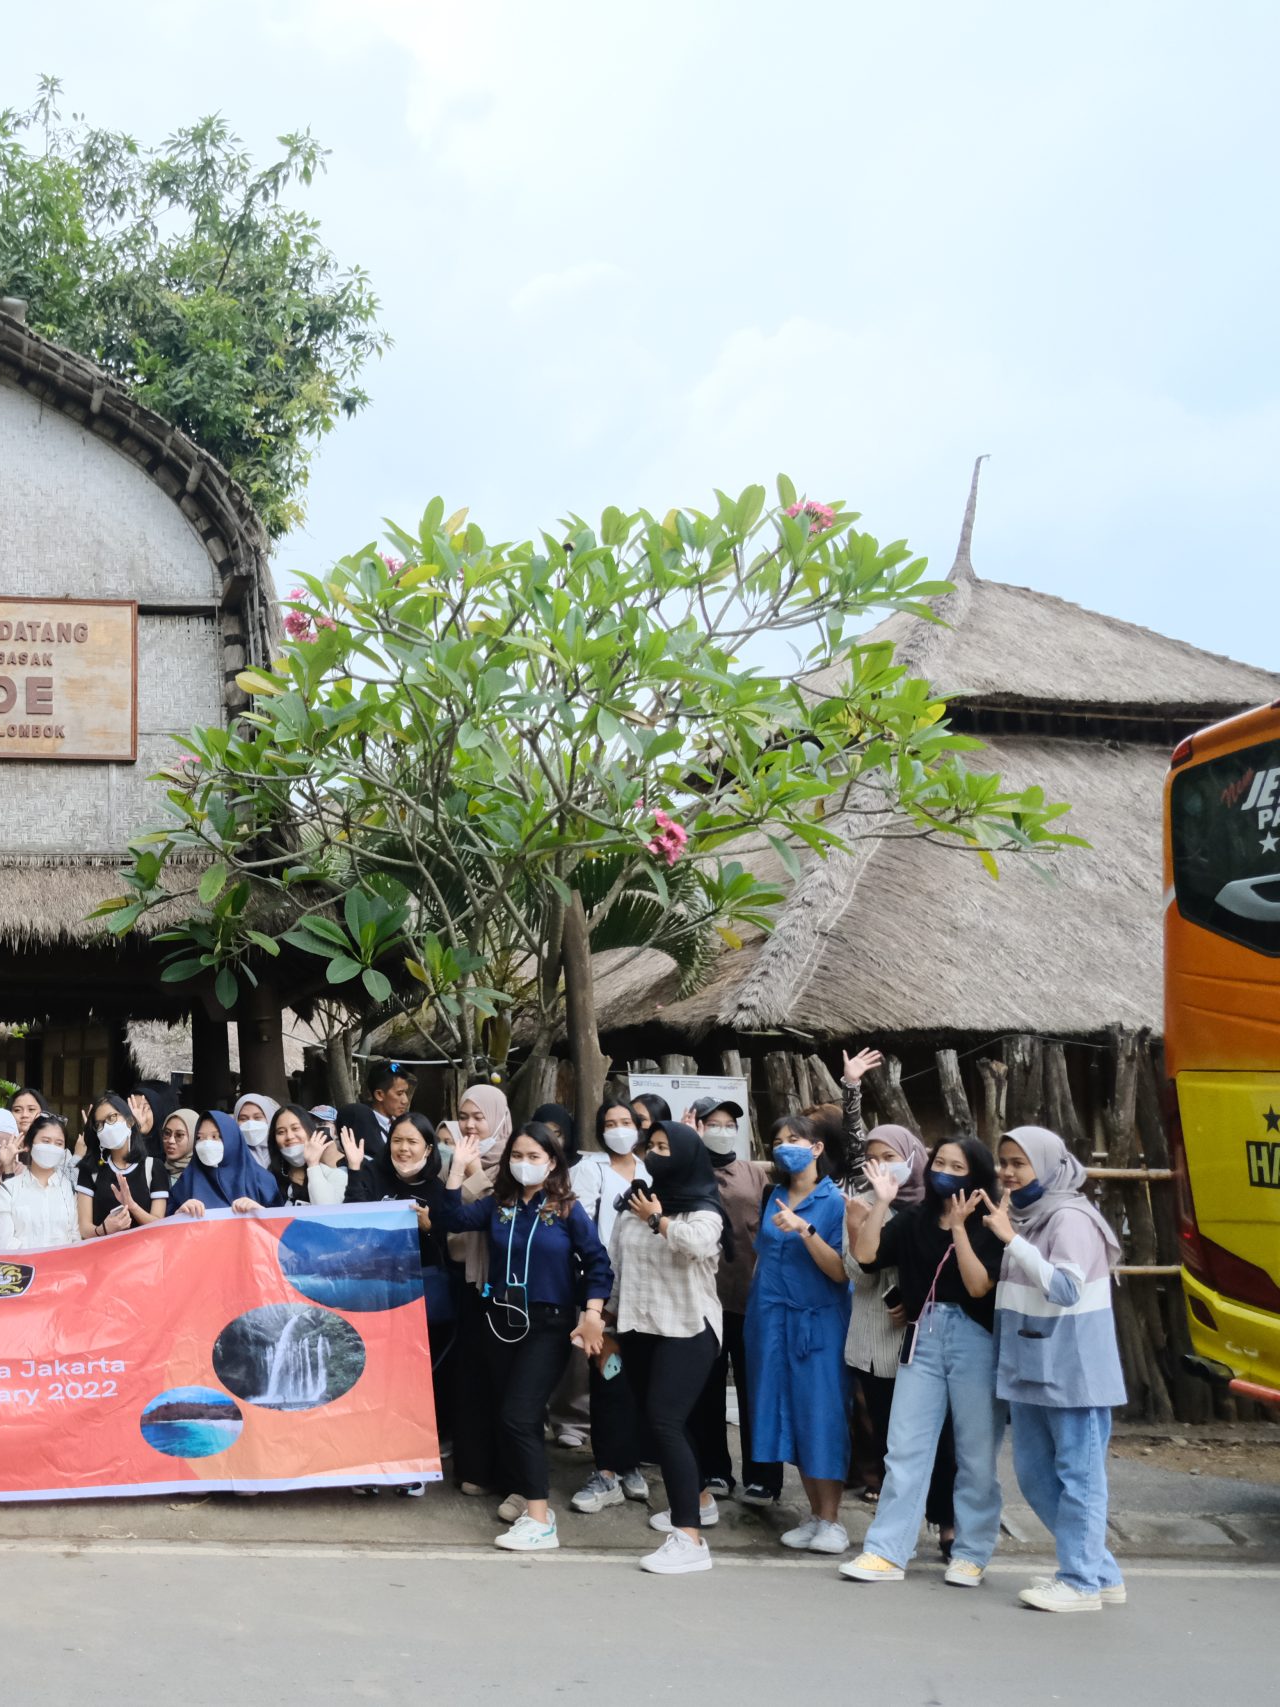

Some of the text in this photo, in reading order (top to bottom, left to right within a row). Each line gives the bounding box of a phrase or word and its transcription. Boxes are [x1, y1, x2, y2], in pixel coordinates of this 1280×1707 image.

[1241, 766, 1280, 811] JE
[20, 1356, 125, 1378] Jakarta
[47, 1380, 119, 1401] 2022
